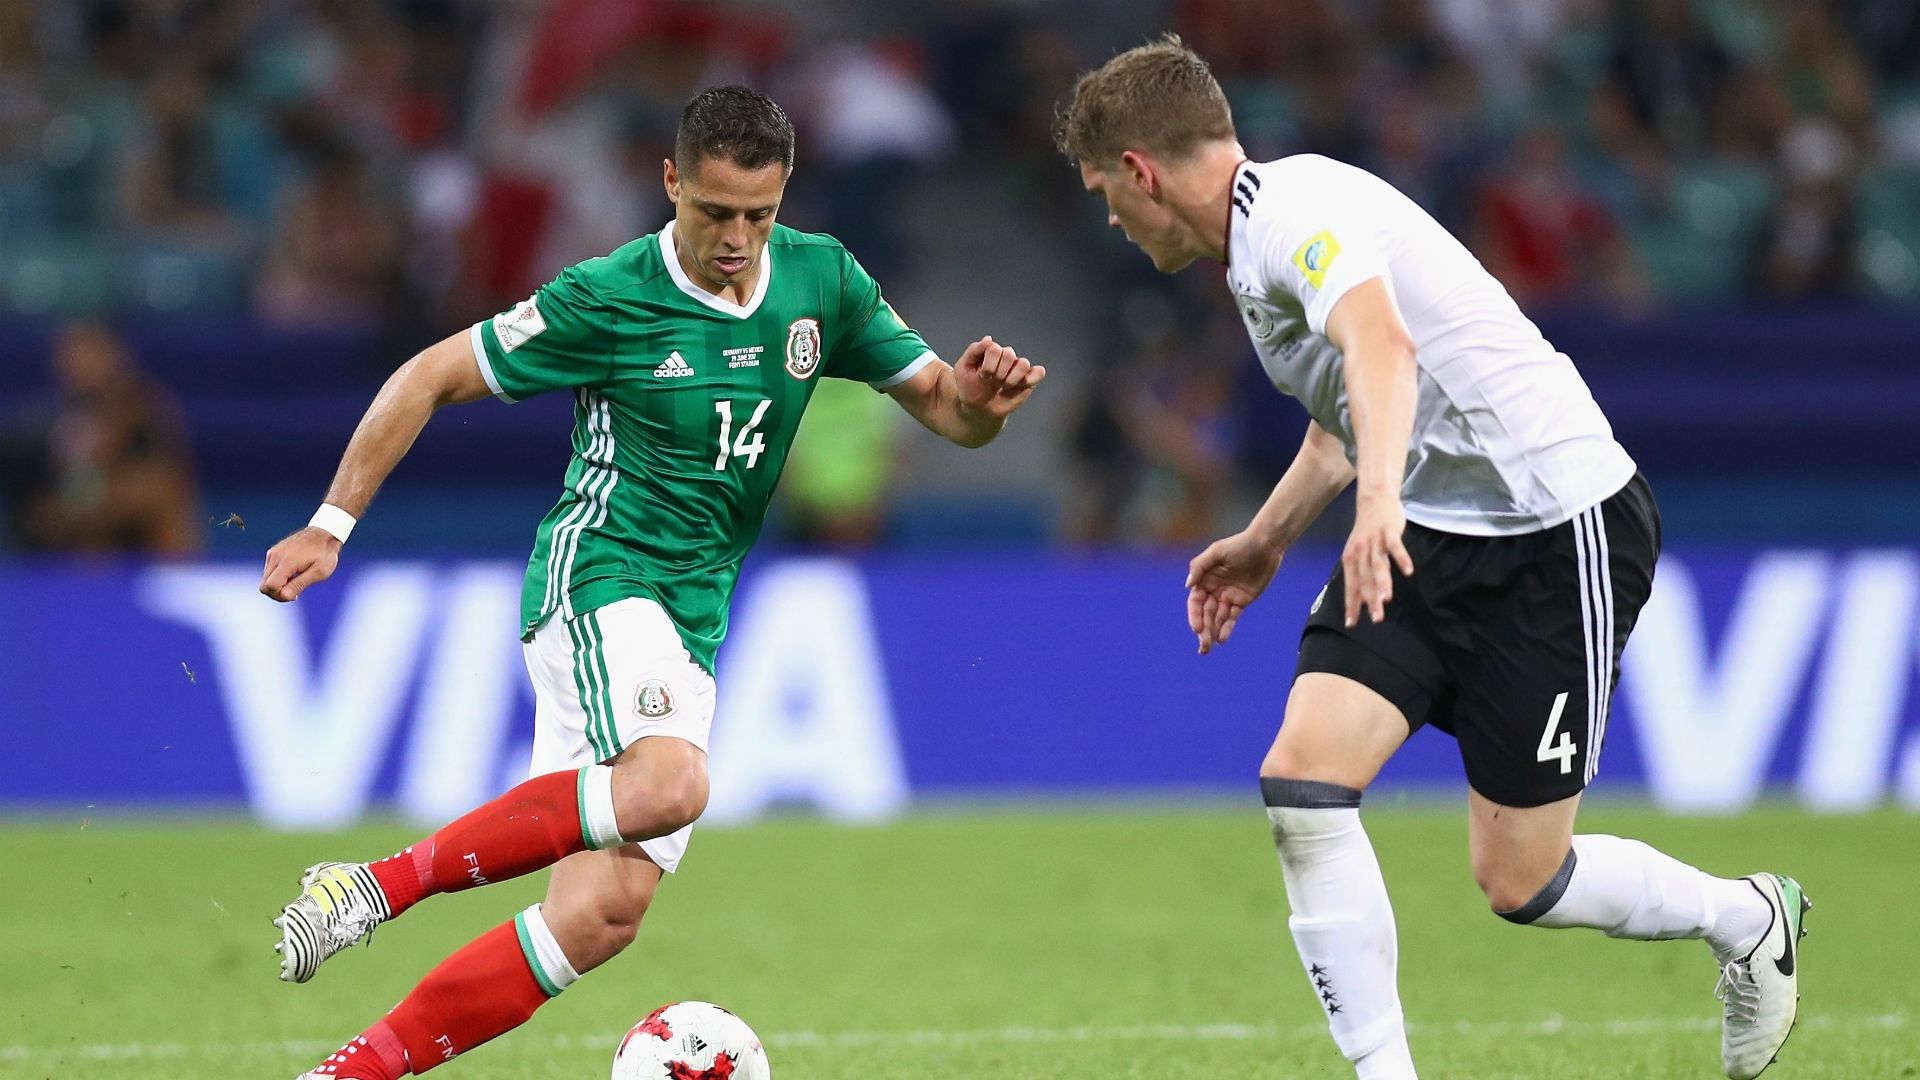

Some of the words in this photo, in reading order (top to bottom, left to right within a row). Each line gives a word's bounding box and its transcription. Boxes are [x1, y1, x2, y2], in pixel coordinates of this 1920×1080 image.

[653, 367, 695, 378] adidas
[715, 399, 773, 470] 14
[138, 560, 912, 828] VIA
[1618, 546, 1920, 816] VI
[1536, 691, 1577, 775] 4
[689, 1033, 697, 1056] adidas
